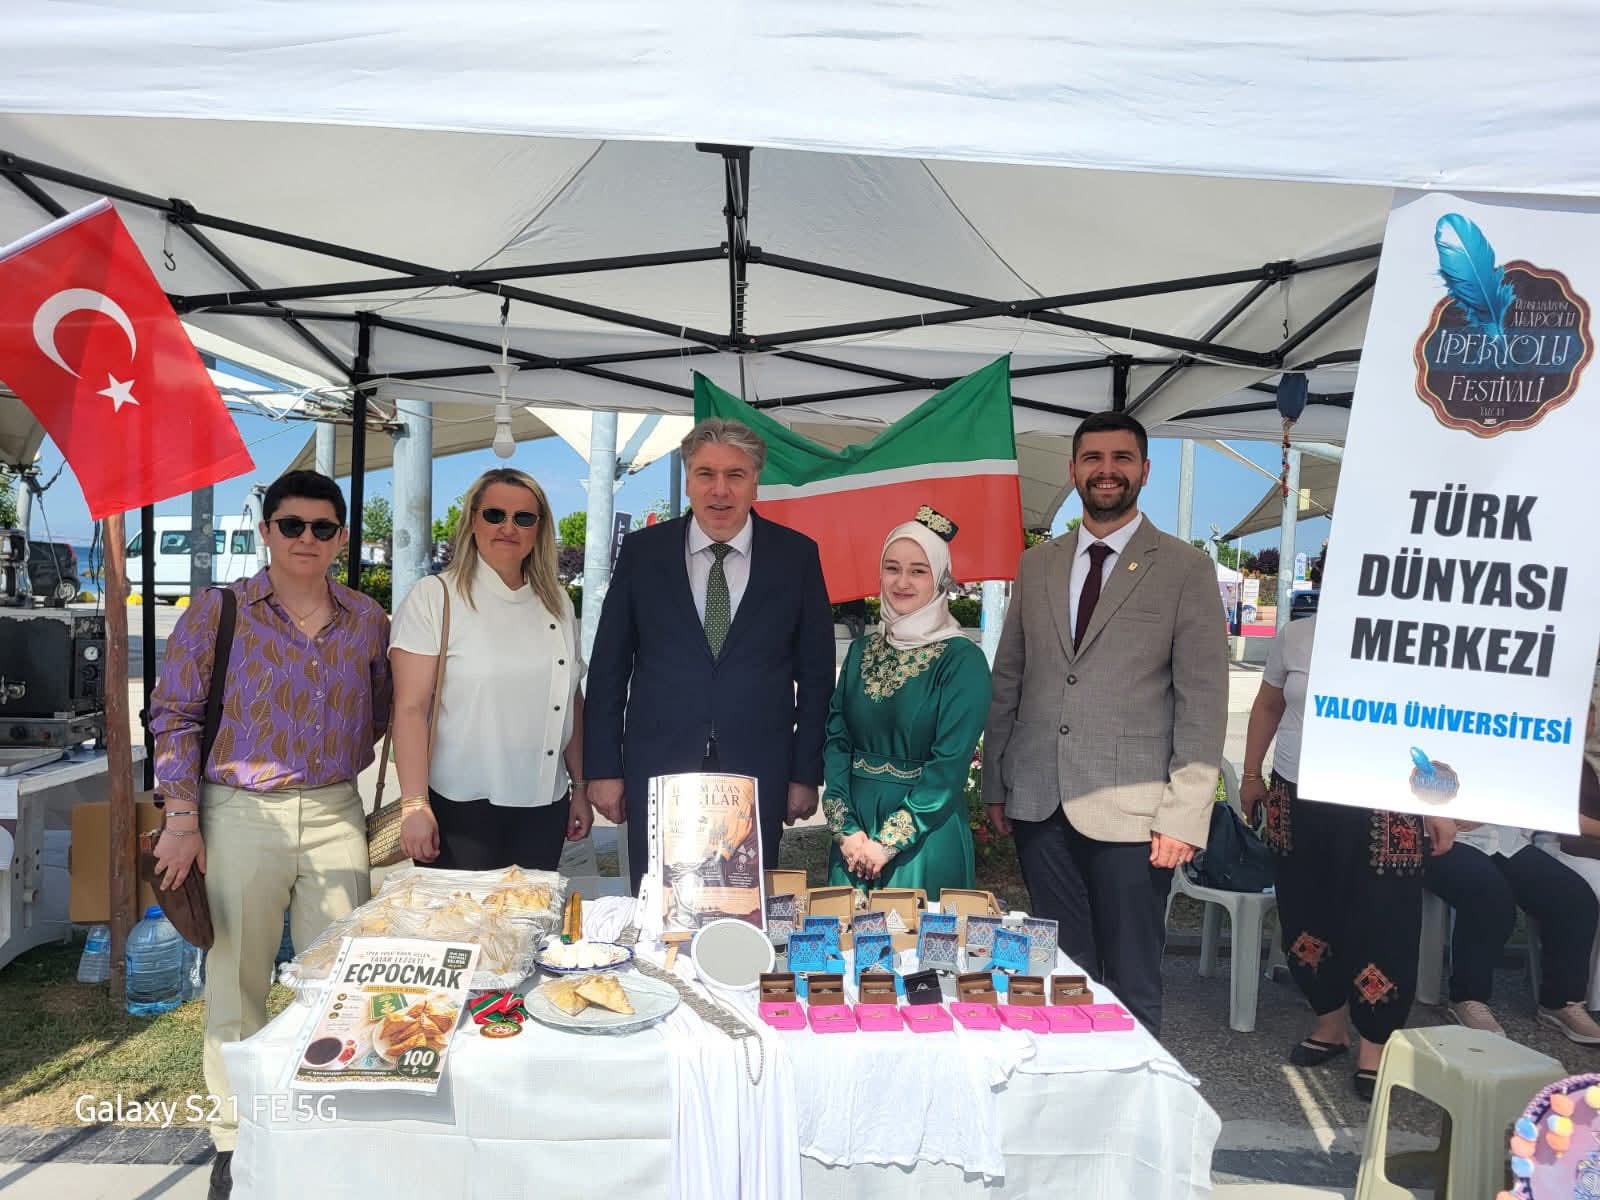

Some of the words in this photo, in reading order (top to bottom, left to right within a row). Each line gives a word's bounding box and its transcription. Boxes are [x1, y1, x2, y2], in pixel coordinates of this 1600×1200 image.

[1409, 483, 1538, 541] TÜRK
[1357, 547, 1568, 612] DÜNYASI
[1350, 617, 1555, 678] MERKEZİ
[1314, 694, 1397, 726] YALOVA
[1404, 701, 1572, 745] ÜNİVERSİTESİ
[403, 1050, 434, 1066] 100
